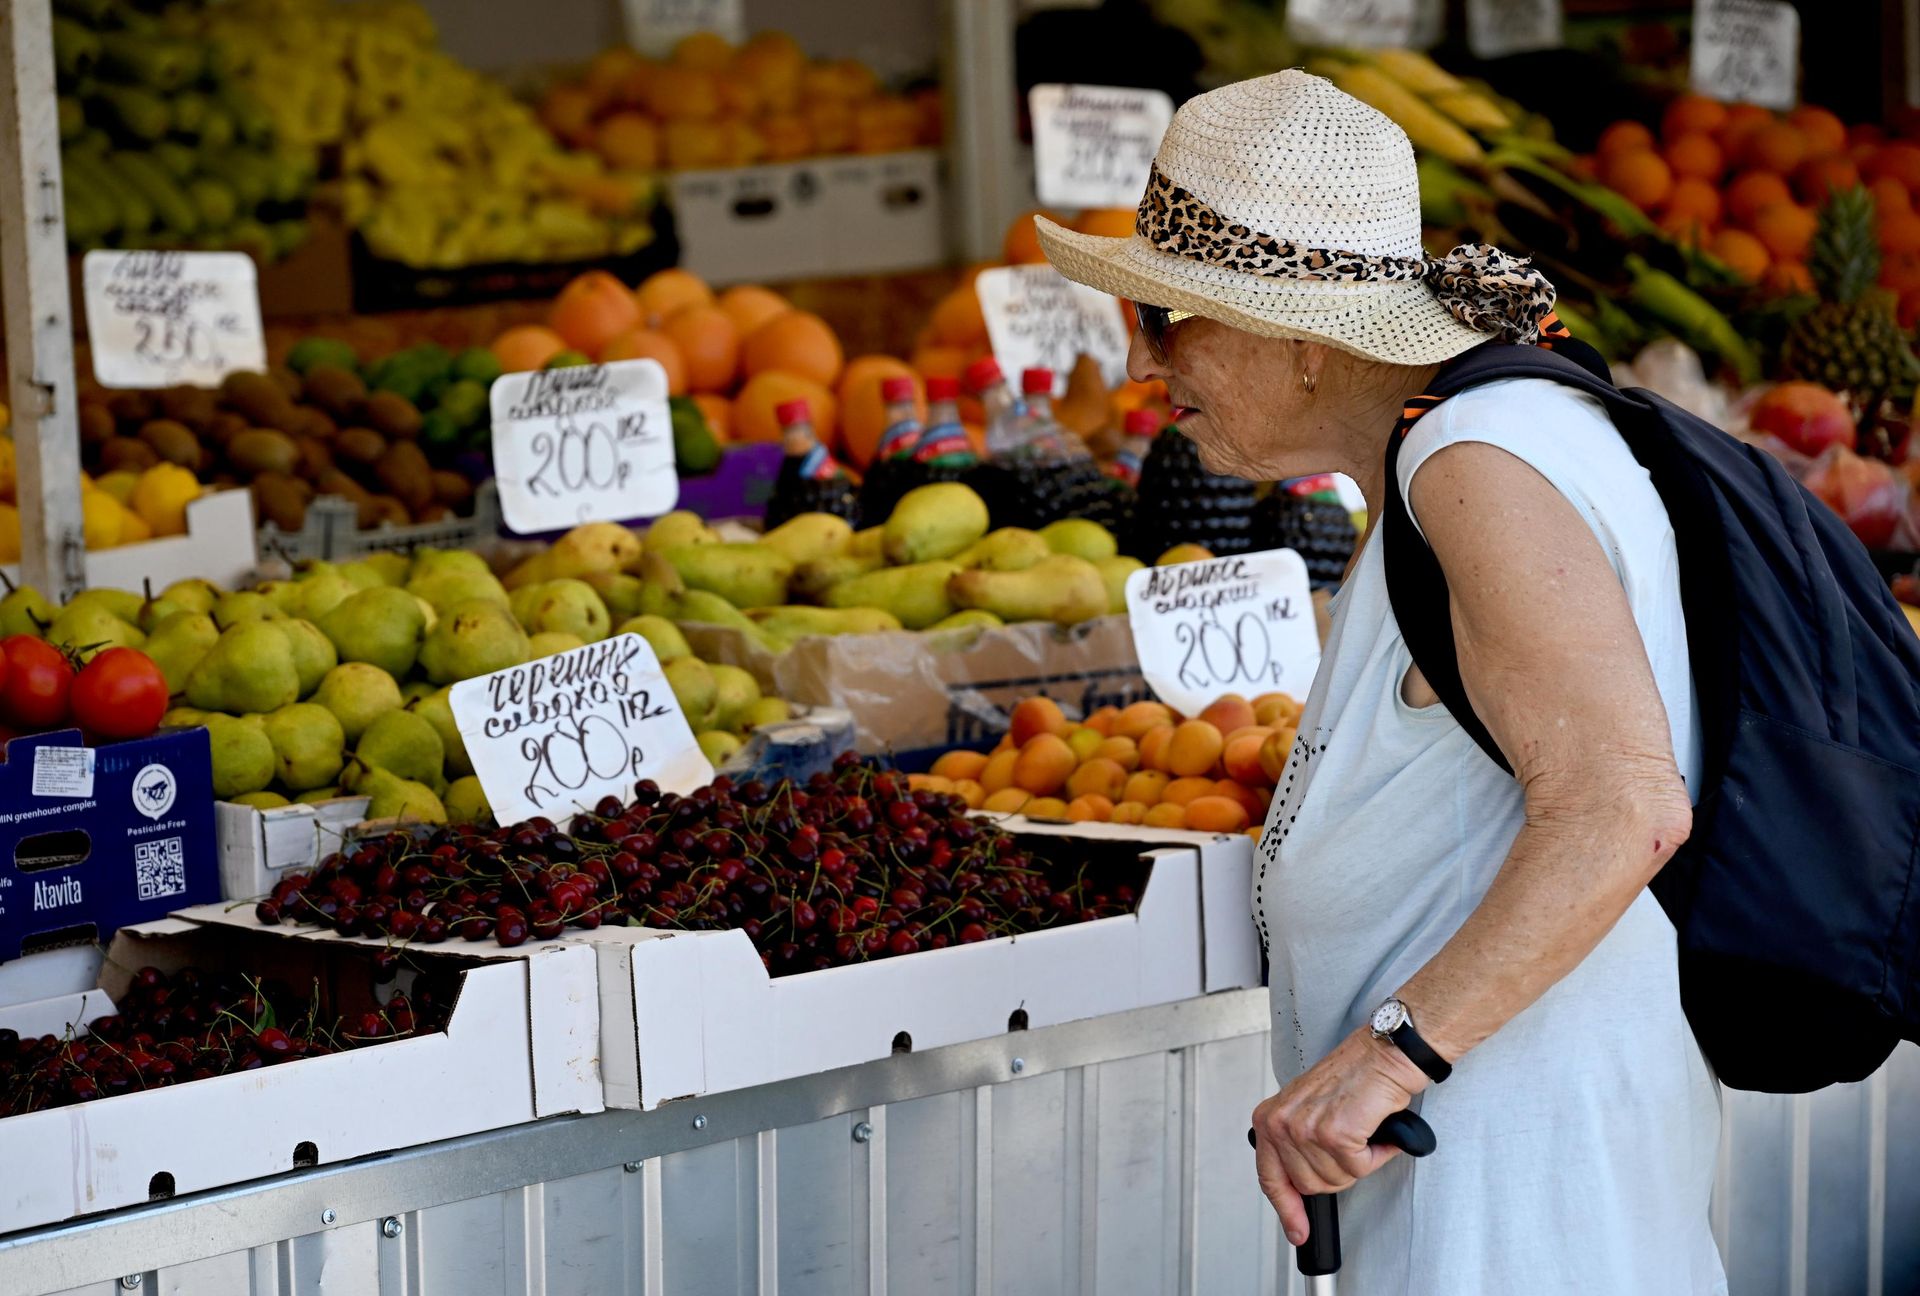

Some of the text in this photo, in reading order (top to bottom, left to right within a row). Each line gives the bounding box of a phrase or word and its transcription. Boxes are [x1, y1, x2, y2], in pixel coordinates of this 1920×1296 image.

[526, 421, 619, 497] 200
[1175, 611, 1271, 690] 200
[521, 714, 629, 809] 200
[15, 806, 62, 824] greenhouse
[62, 799, 97, 814] complex
[127, 819, 187, 837] Pesticide Free
[0, 877, 12, 888] lfa
[33, 875, 82, 912] Atavita
